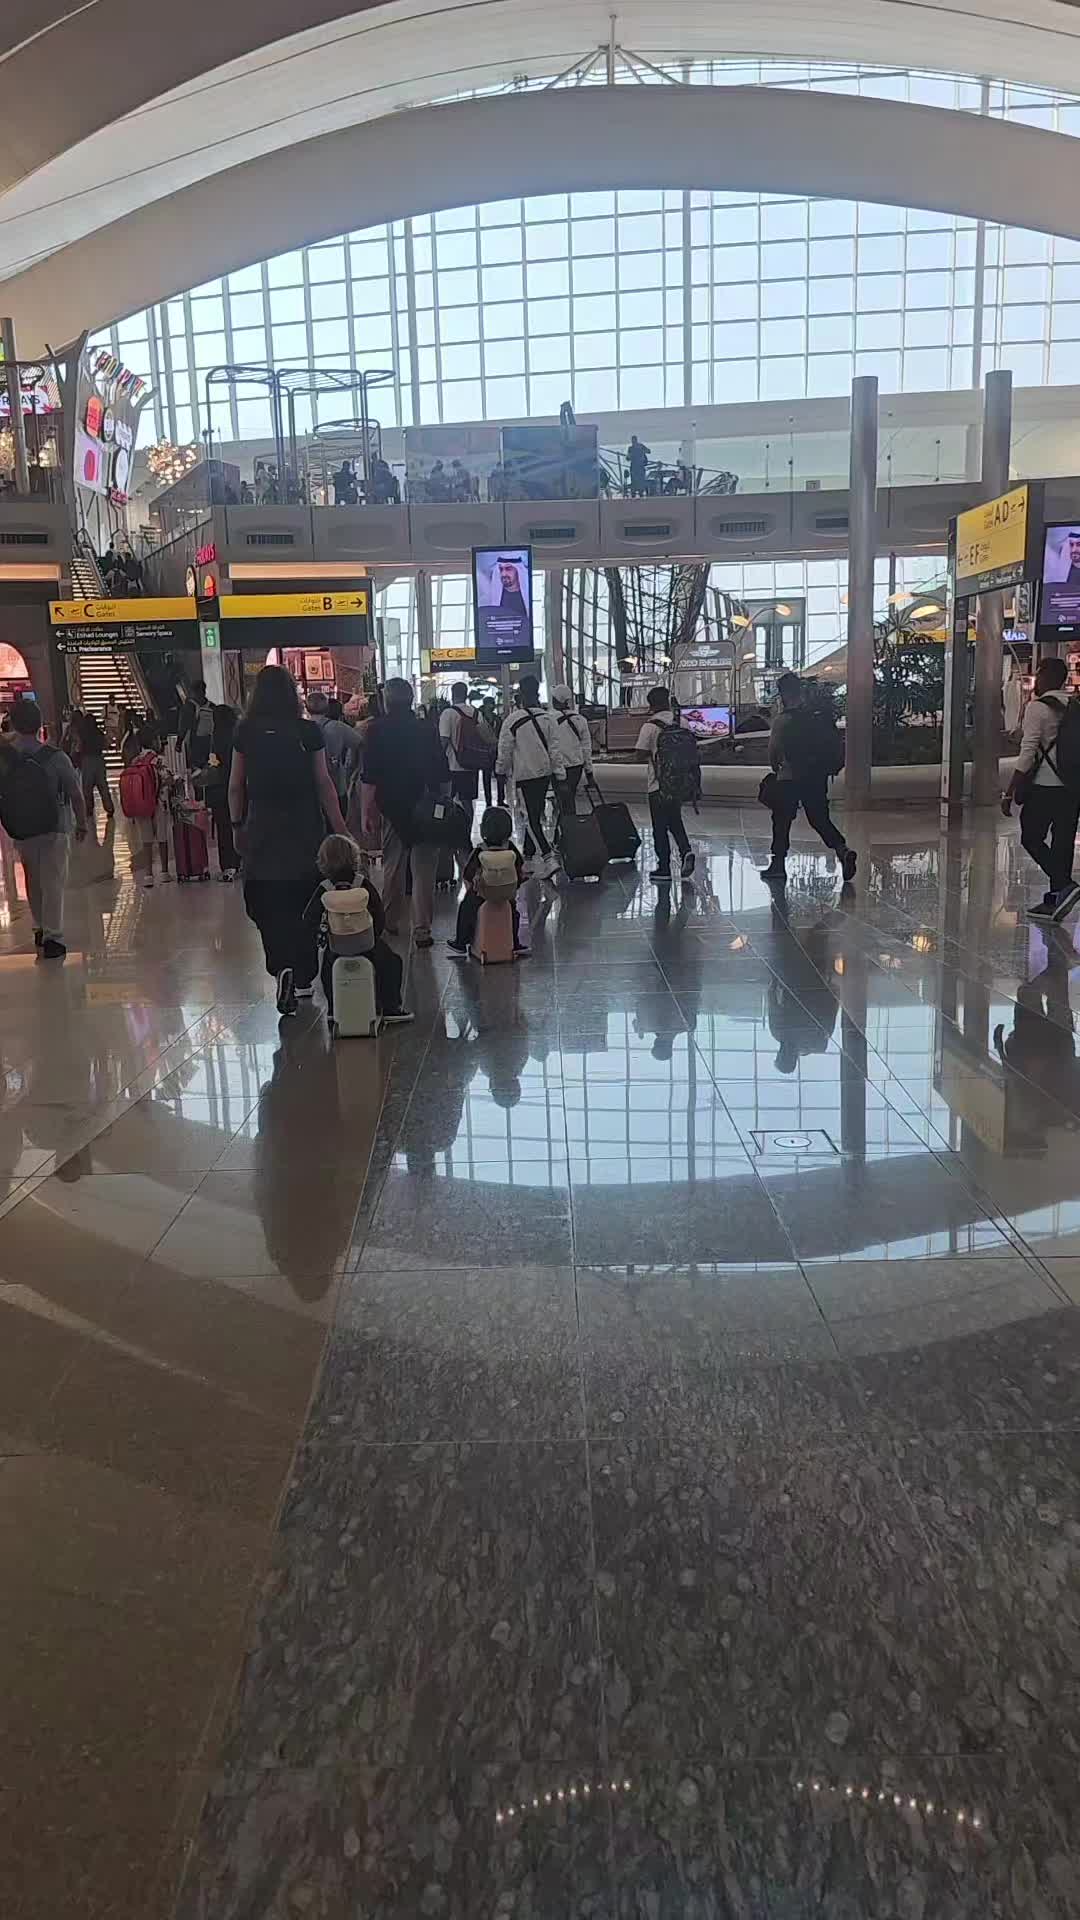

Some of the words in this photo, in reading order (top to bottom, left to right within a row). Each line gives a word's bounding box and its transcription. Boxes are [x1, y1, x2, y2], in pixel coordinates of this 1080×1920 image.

[323, 597, 332, 610] B
[84, 604, 95, 617] C
[95, 631, 119, 639] Lounges
